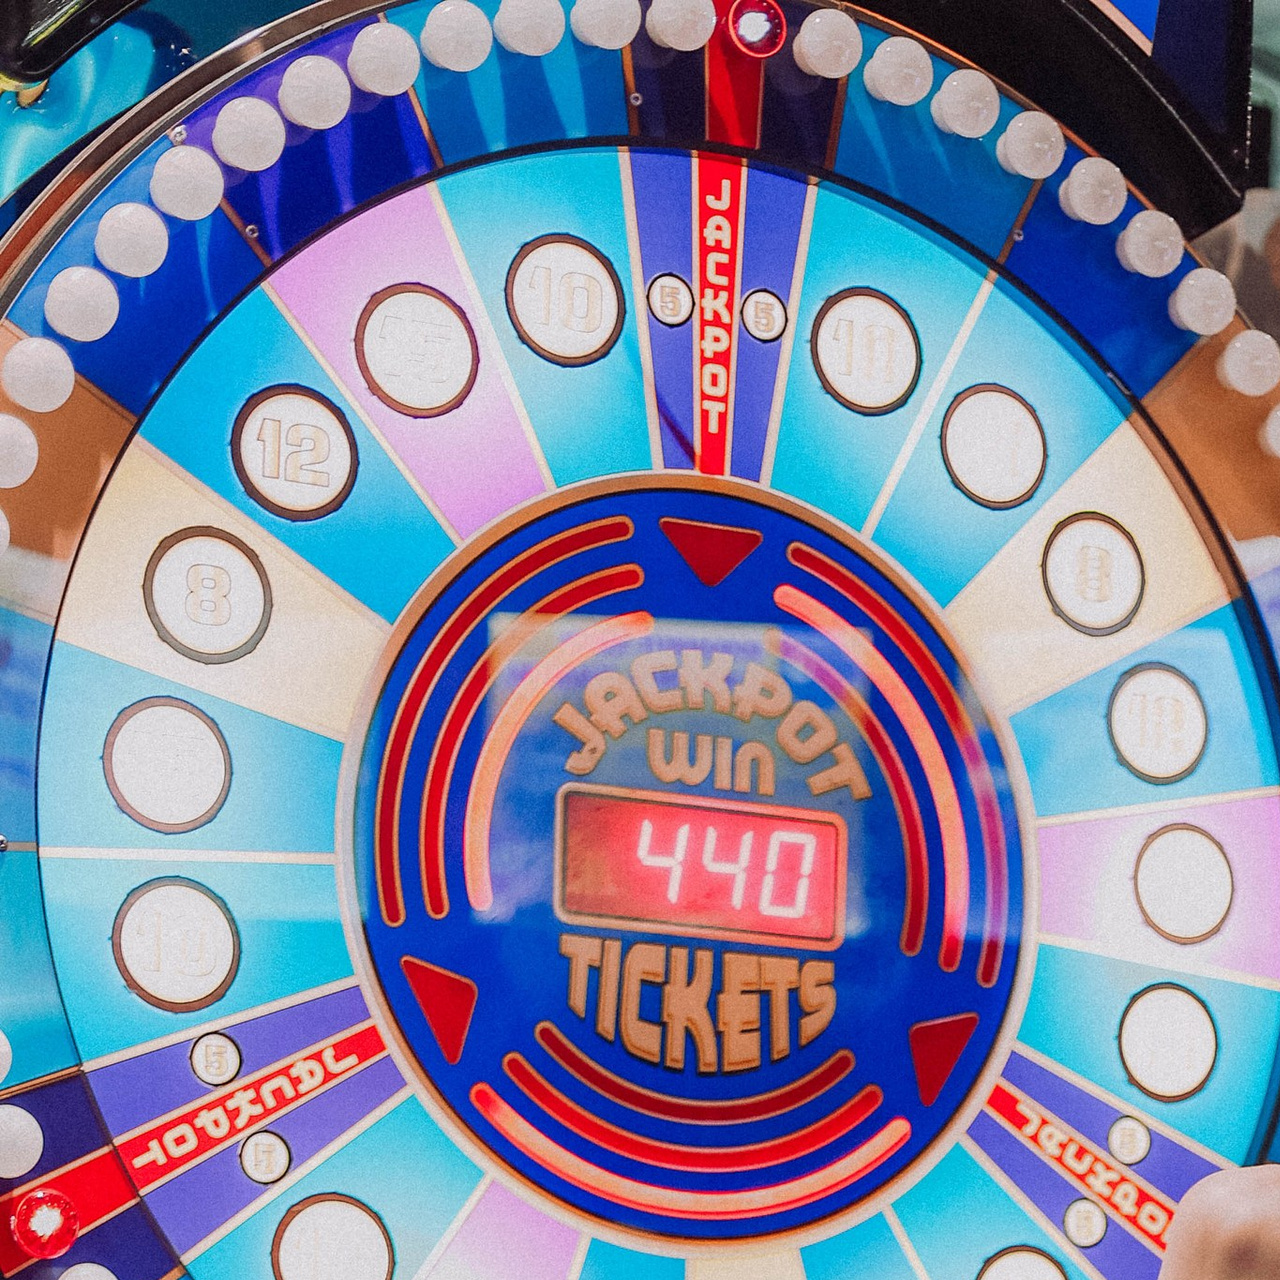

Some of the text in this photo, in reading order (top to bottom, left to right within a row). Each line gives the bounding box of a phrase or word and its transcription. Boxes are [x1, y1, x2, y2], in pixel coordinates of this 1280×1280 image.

[659, 284, 682, 318] 5
[700, 178, 732, 434] JACKPOT
[754, 300, 776, 334] 5
[256, 417, 331, 488] 12
[184, 562, 232, 627] 8
[552, 648, 873, 801] JACKPOT
[645, 727, 776, 797] WIN
[636, 818, 817, 919] 440
[559, 932, 837, 1076] TICKETS
[131, 1046, 360, 1170] JACKPOT
[1014, 1102, 1172, 1246] JACKPO
